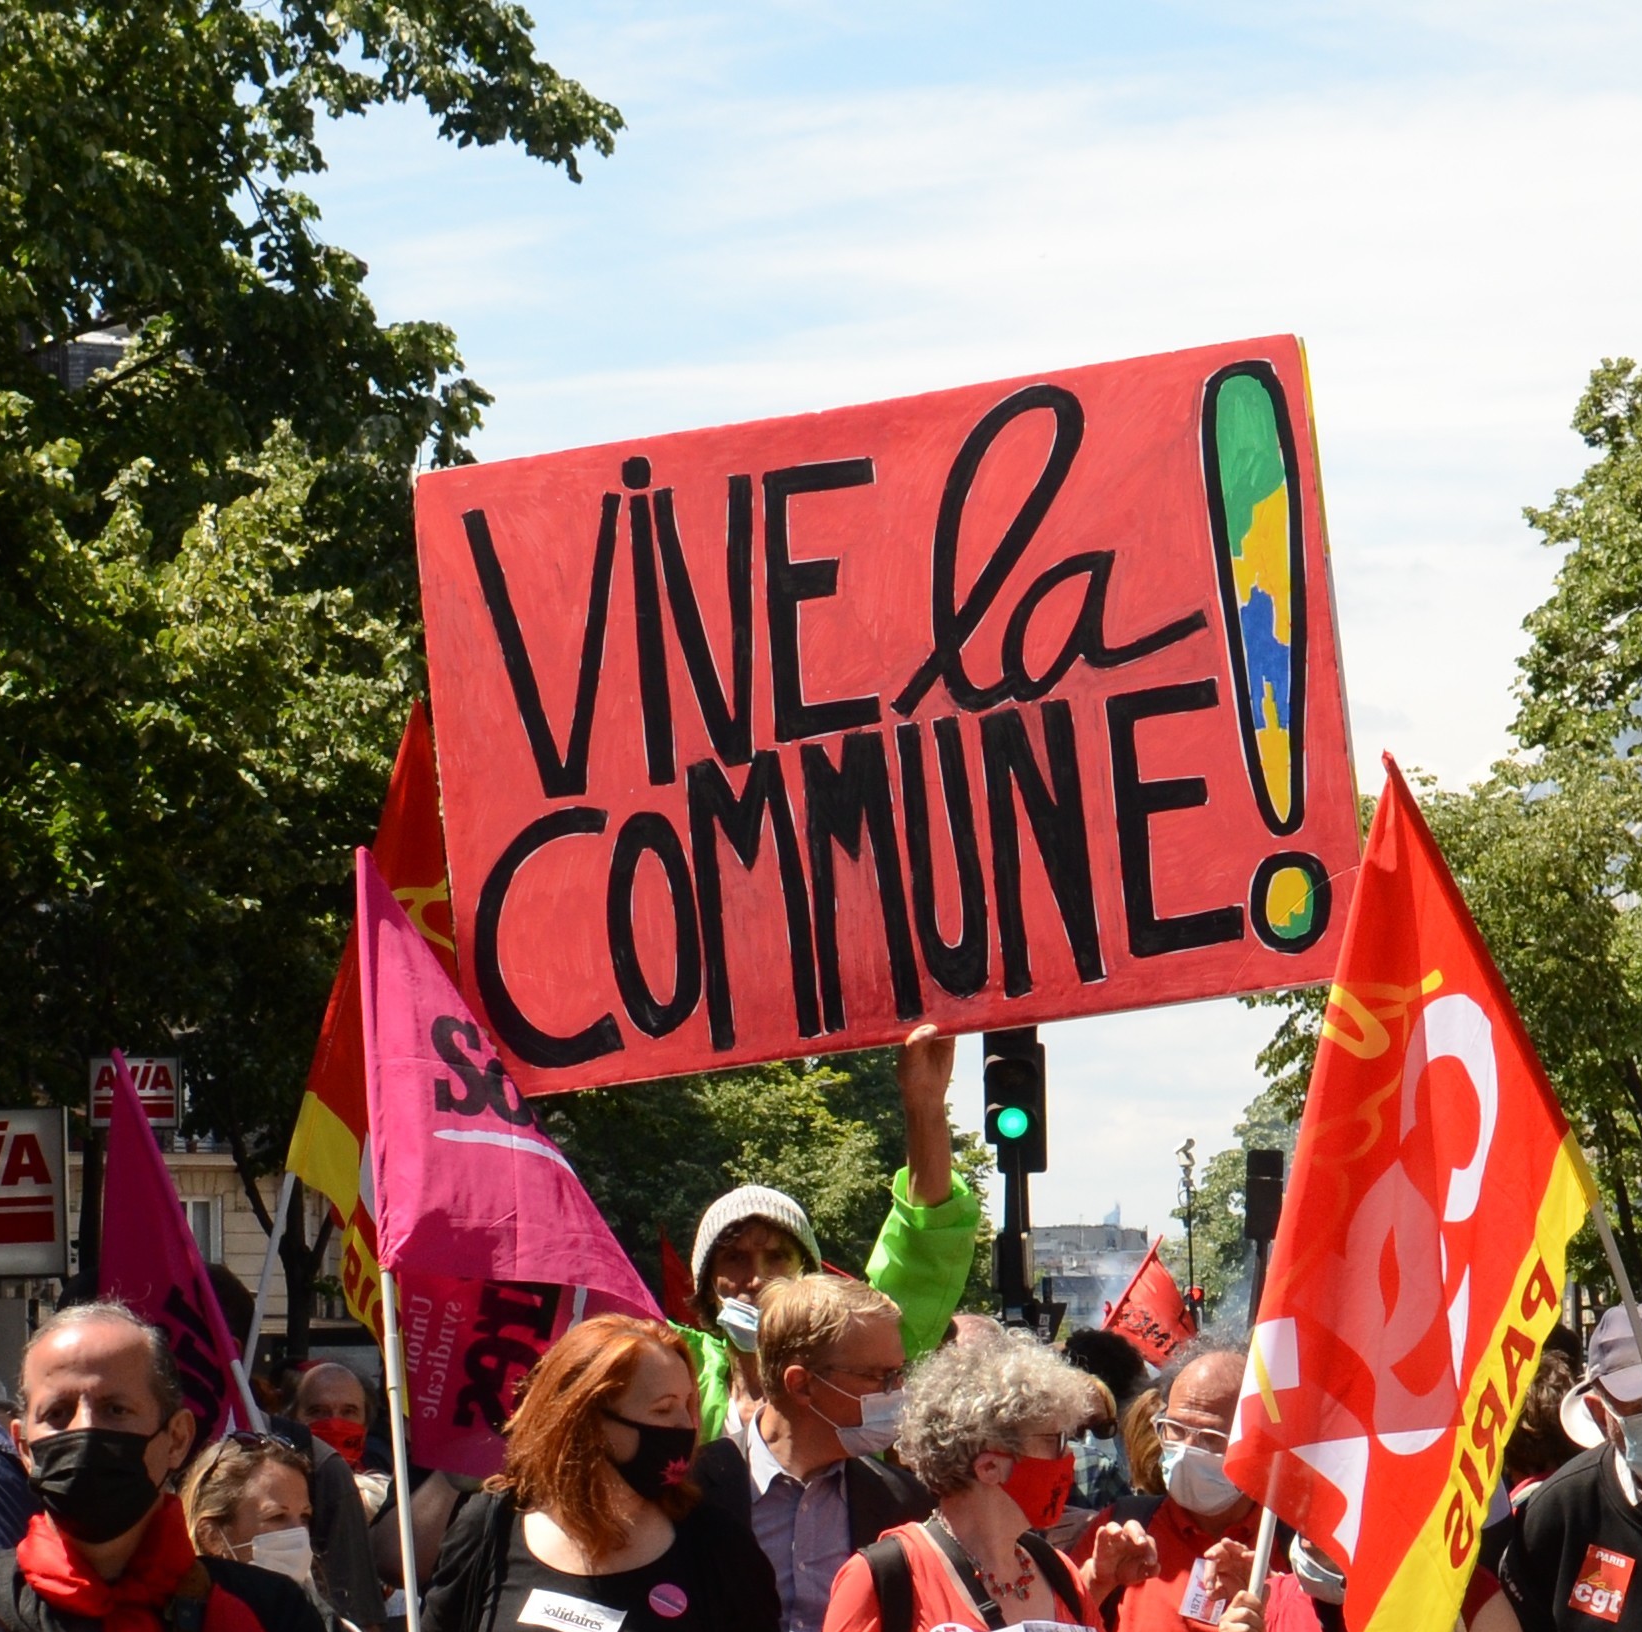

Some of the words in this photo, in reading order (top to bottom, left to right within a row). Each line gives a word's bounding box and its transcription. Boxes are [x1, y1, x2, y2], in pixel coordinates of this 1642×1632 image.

[1595, 1550, 1627, 1569] PARIS
[1189, 1593, 1204, 1616] 1871
[1574, 1583, 1623, 1614] cgt
